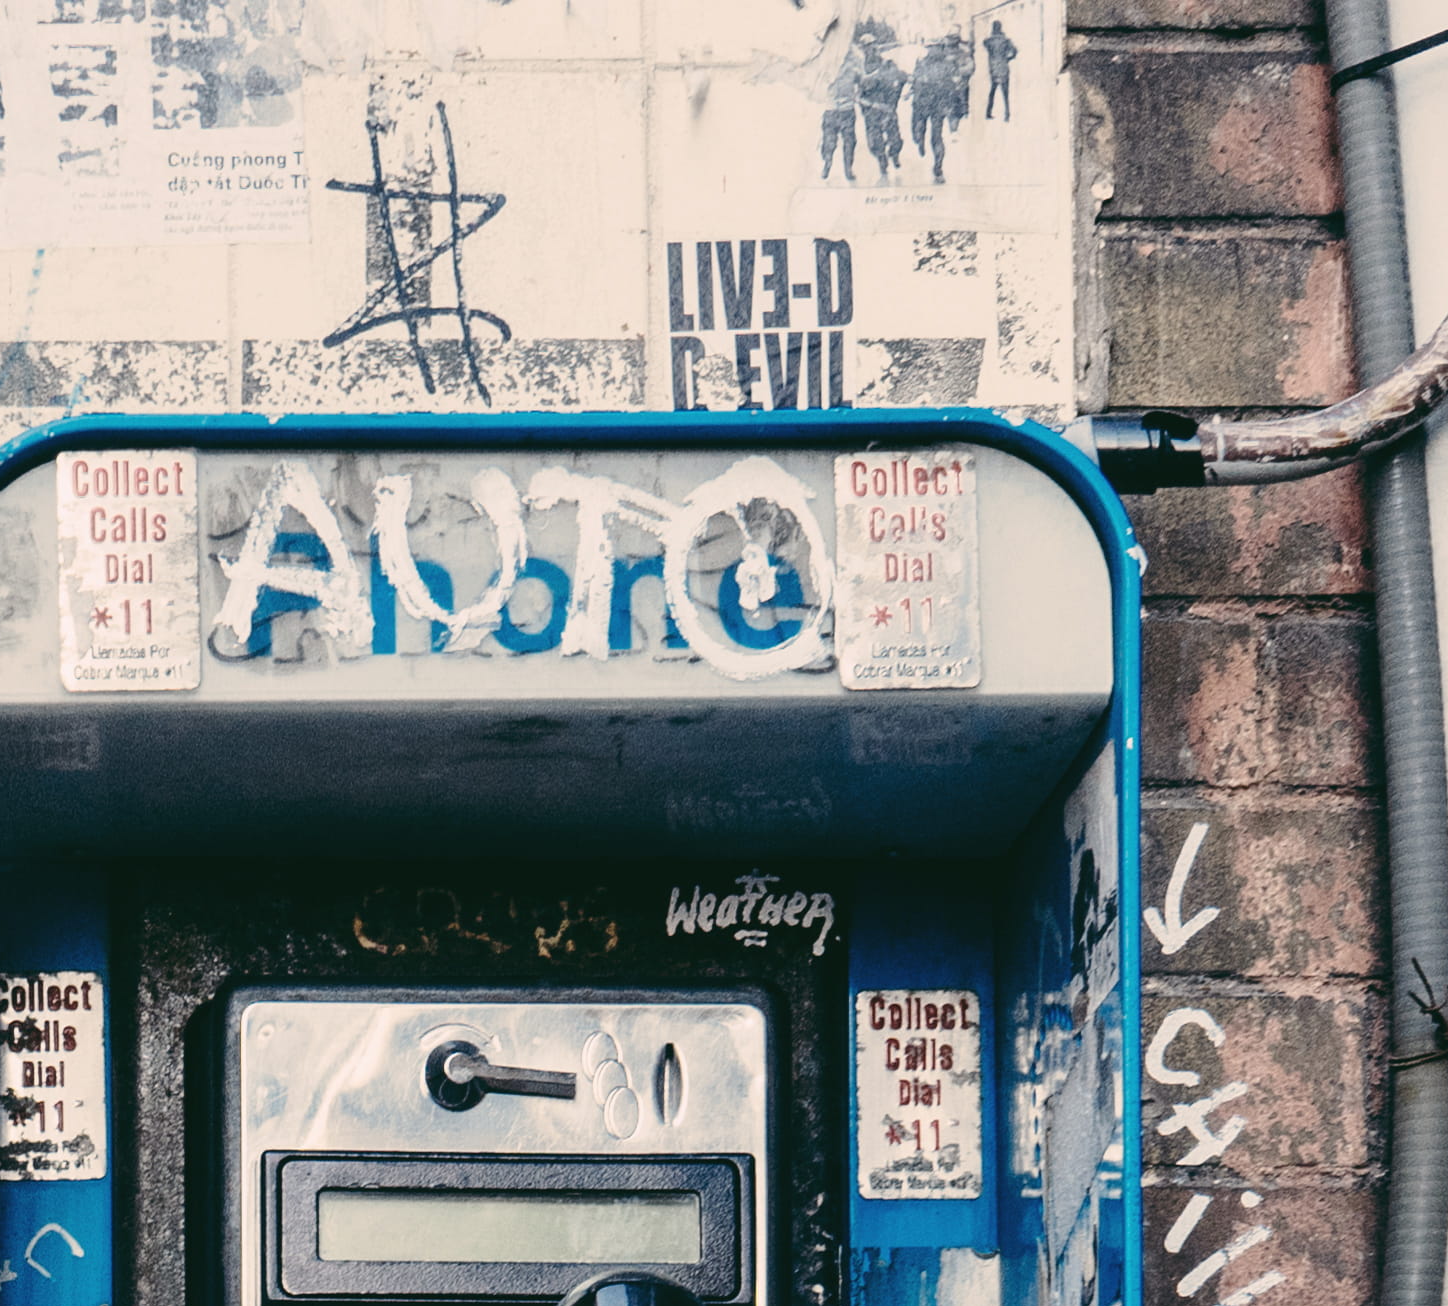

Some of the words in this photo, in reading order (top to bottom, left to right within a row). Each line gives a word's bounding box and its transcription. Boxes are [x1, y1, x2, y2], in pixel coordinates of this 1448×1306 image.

[72, 460, 184, 497] Collect
[851, 460, 963, 497] Collect
[90, 507, 167, 543] Calls
[105, 554, 153, 584] Dial
[884, 552, 933, 582] Dial
[870, 997, 969, 1031] Collect
[886, 1038, 953, 1071] Calls
[22, 1061, 64, 1087] Dial
[899, 1079, 941, 1106] Dial
